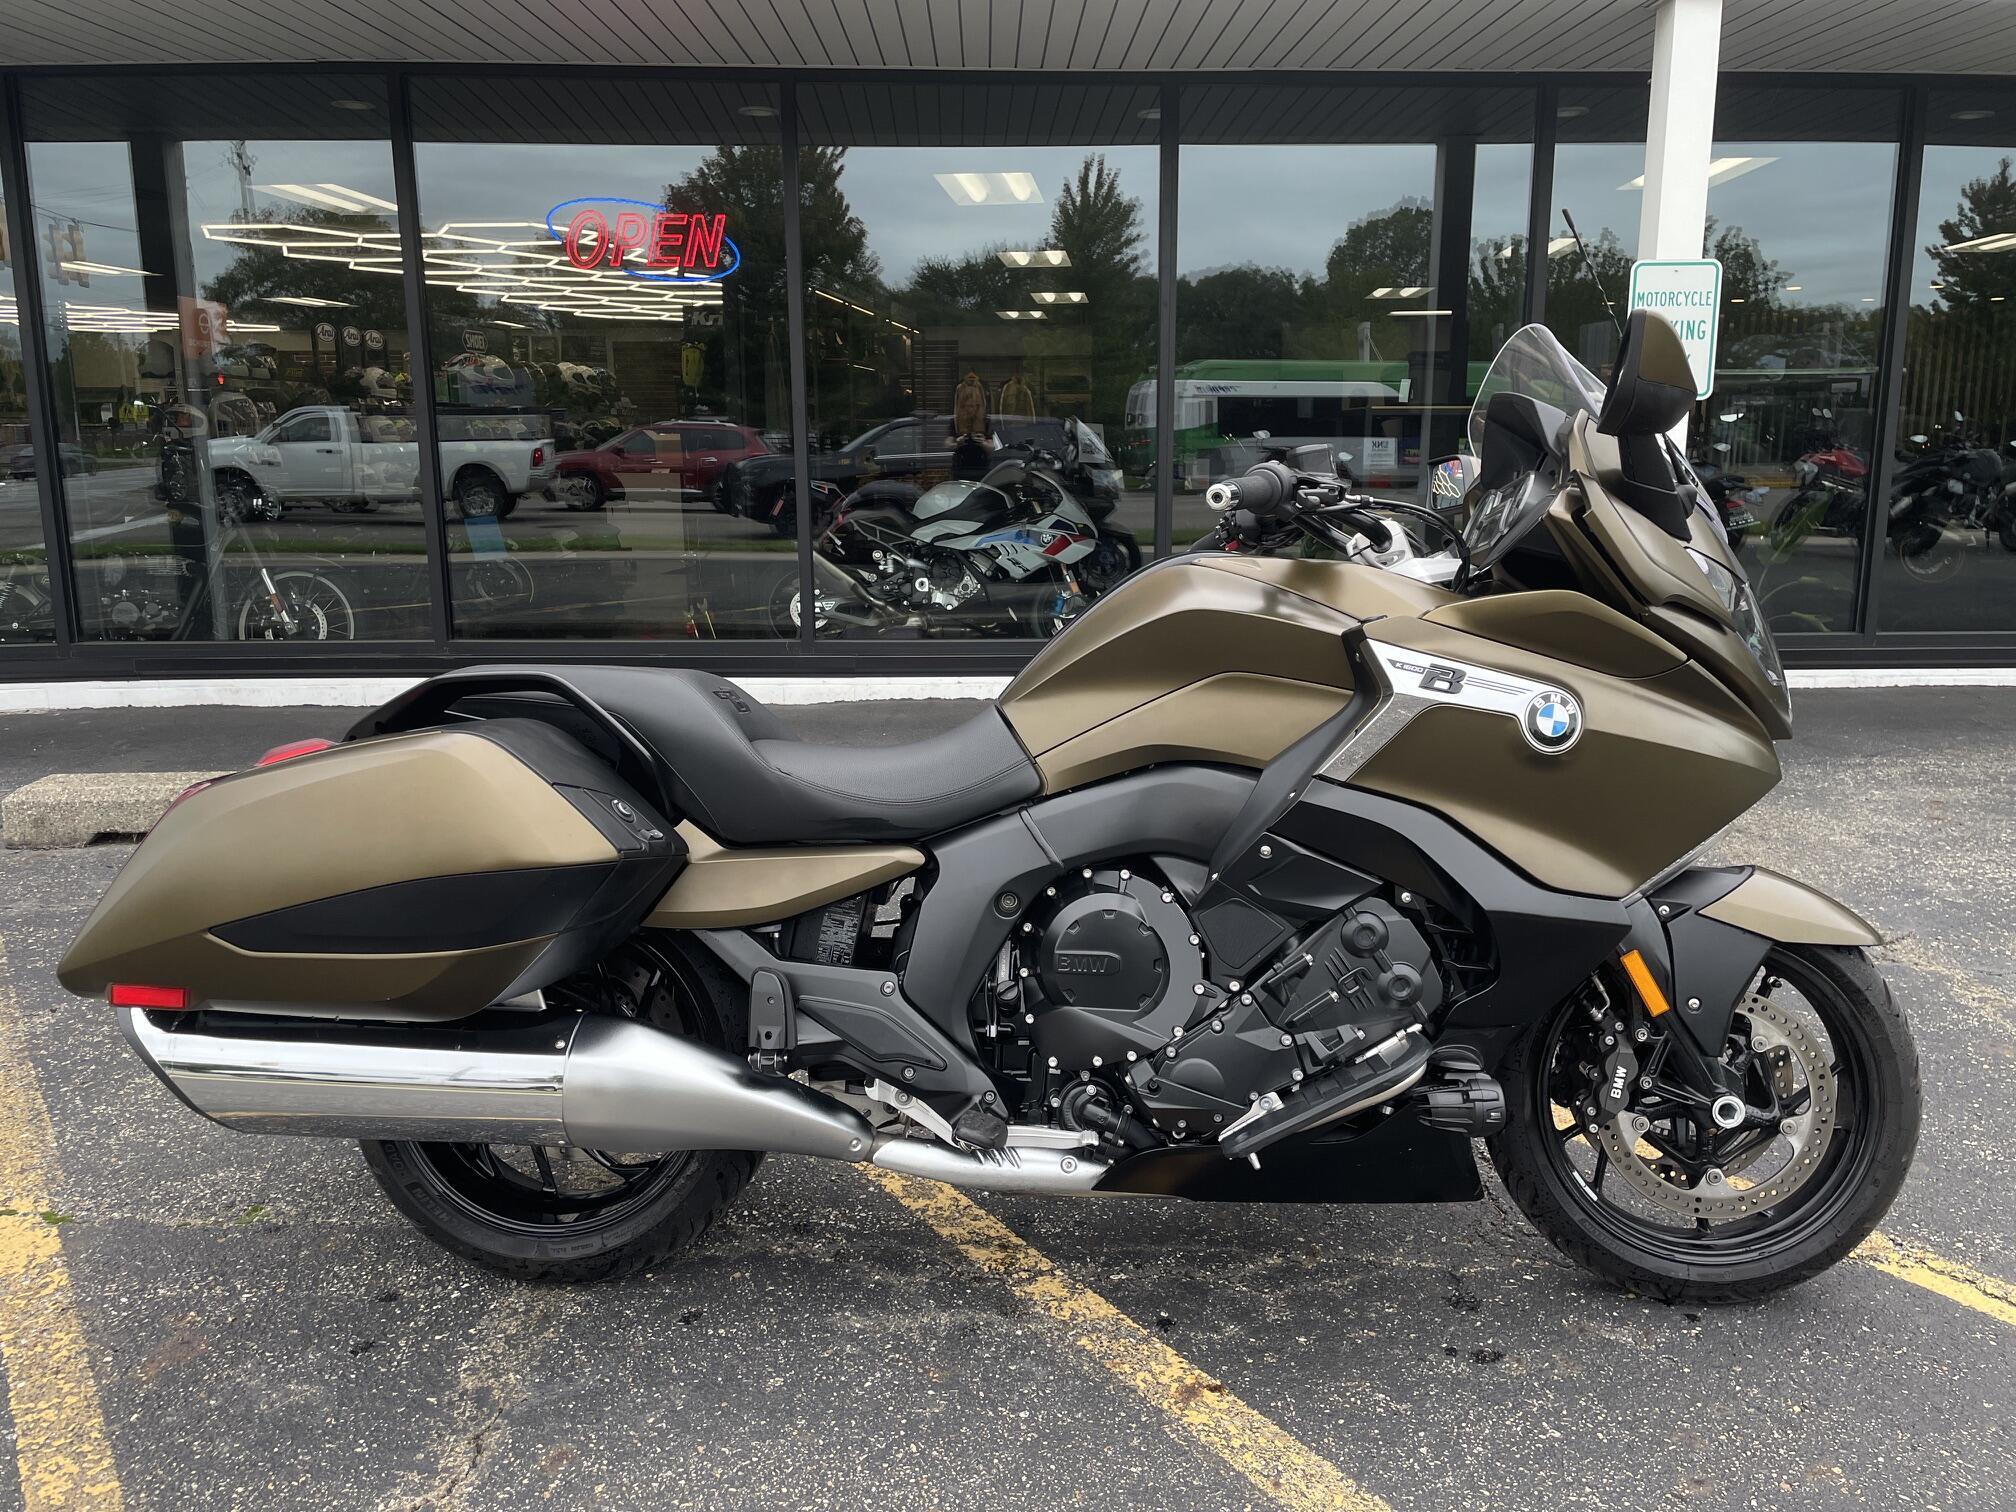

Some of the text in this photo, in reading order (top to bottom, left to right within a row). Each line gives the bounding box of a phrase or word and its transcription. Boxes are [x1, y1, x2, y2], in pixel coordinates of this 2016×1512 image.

[566, 209, 726, 270] OPEN
[1636, 291, 1712, 307] MOTORCYCLE
[318, 326, 334, 337] Arai
[1403, 663, 1424, 674] 1600
[1533, 692, 1577, 716] BMW
[1057, 956, 1109, 974] BMW
[1610, 1064, 1628, 1099] BMW
